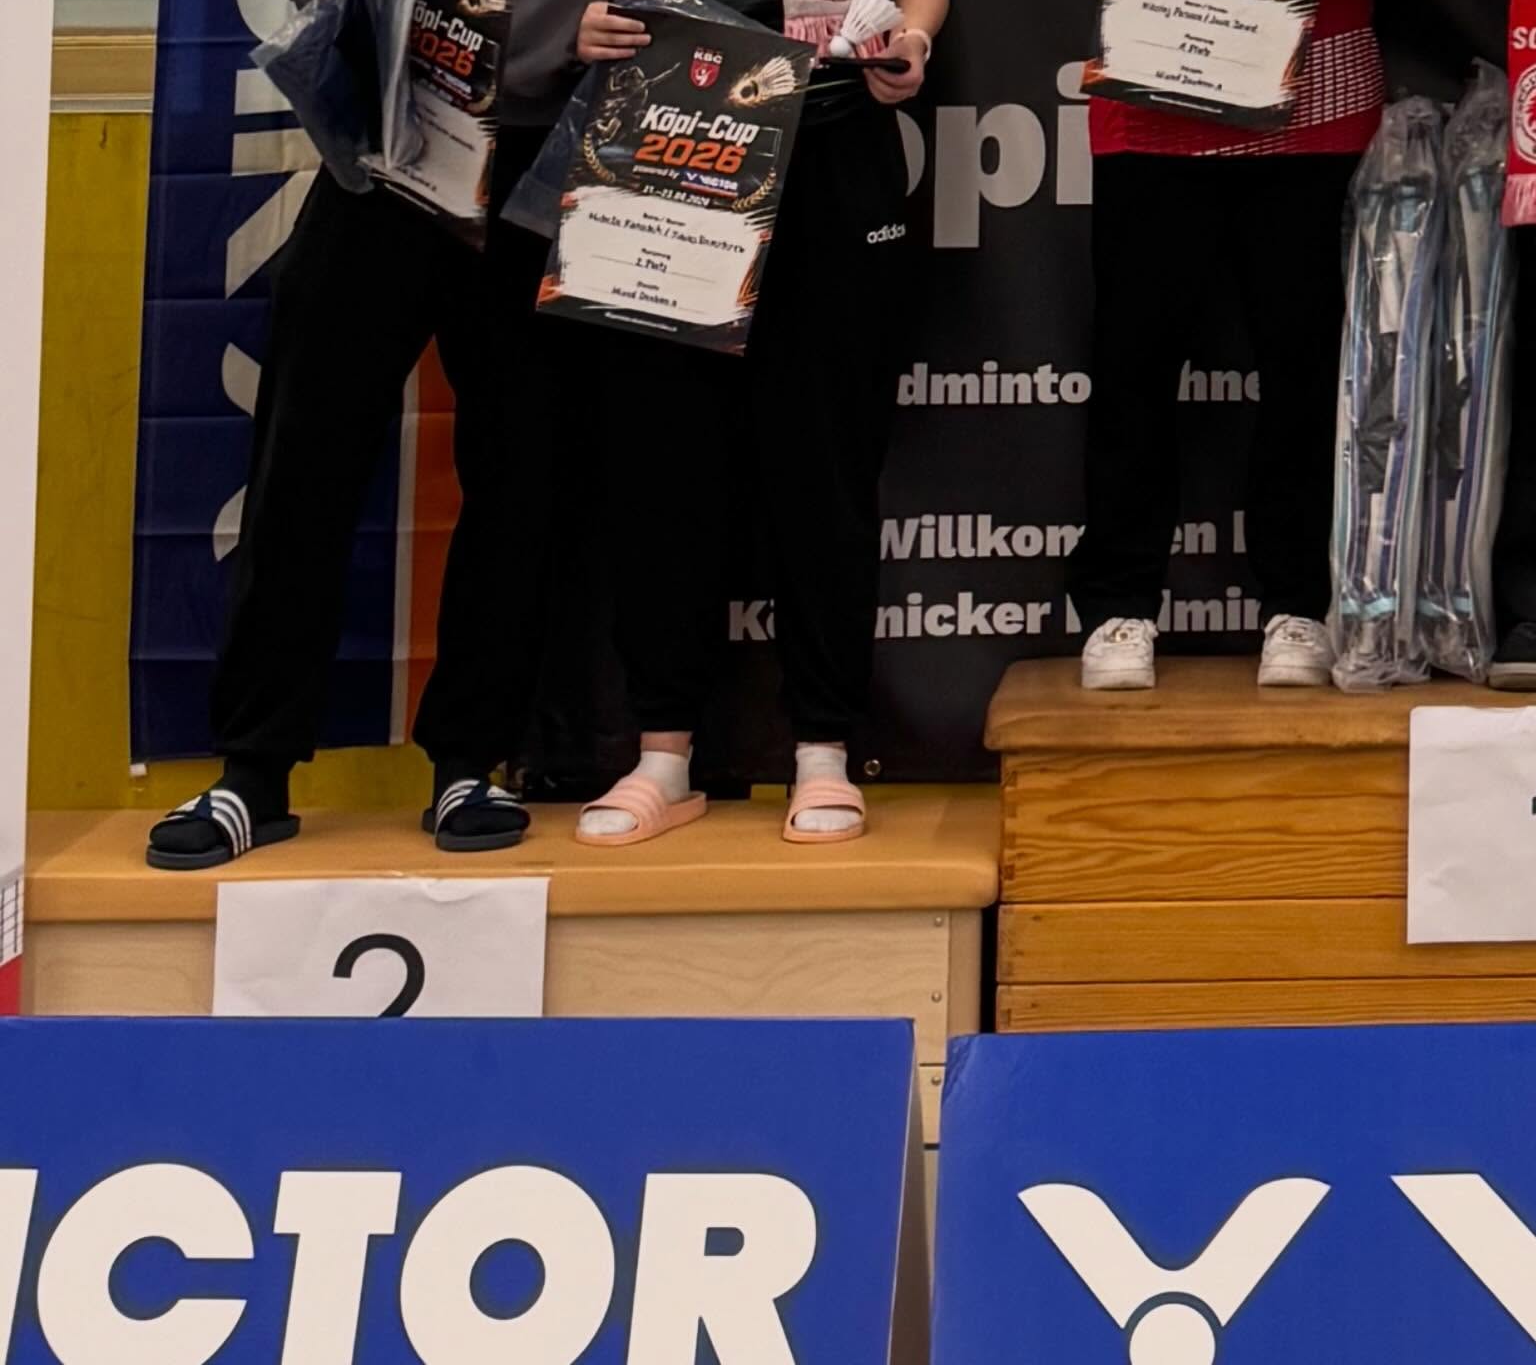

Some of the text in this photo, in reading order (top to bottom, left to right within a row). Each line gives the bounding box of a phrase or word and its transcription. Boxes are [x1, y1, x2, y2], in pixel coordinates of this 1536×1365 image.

[413, 0, 484, 52] öpi-Cup
[694, 51, 723, 64] KBC
[640, 104, 760, 146] Köpi-Cup
[635, 134, 748, 174] 2026
[866, 223, 906, 245] adida
[896, 361, 1093, 406] dminto
[728, 592, 1052, 641] Knicker
[332, 932, 426, 1017] 2
[0, 1163, 817, 1365] CTOR
